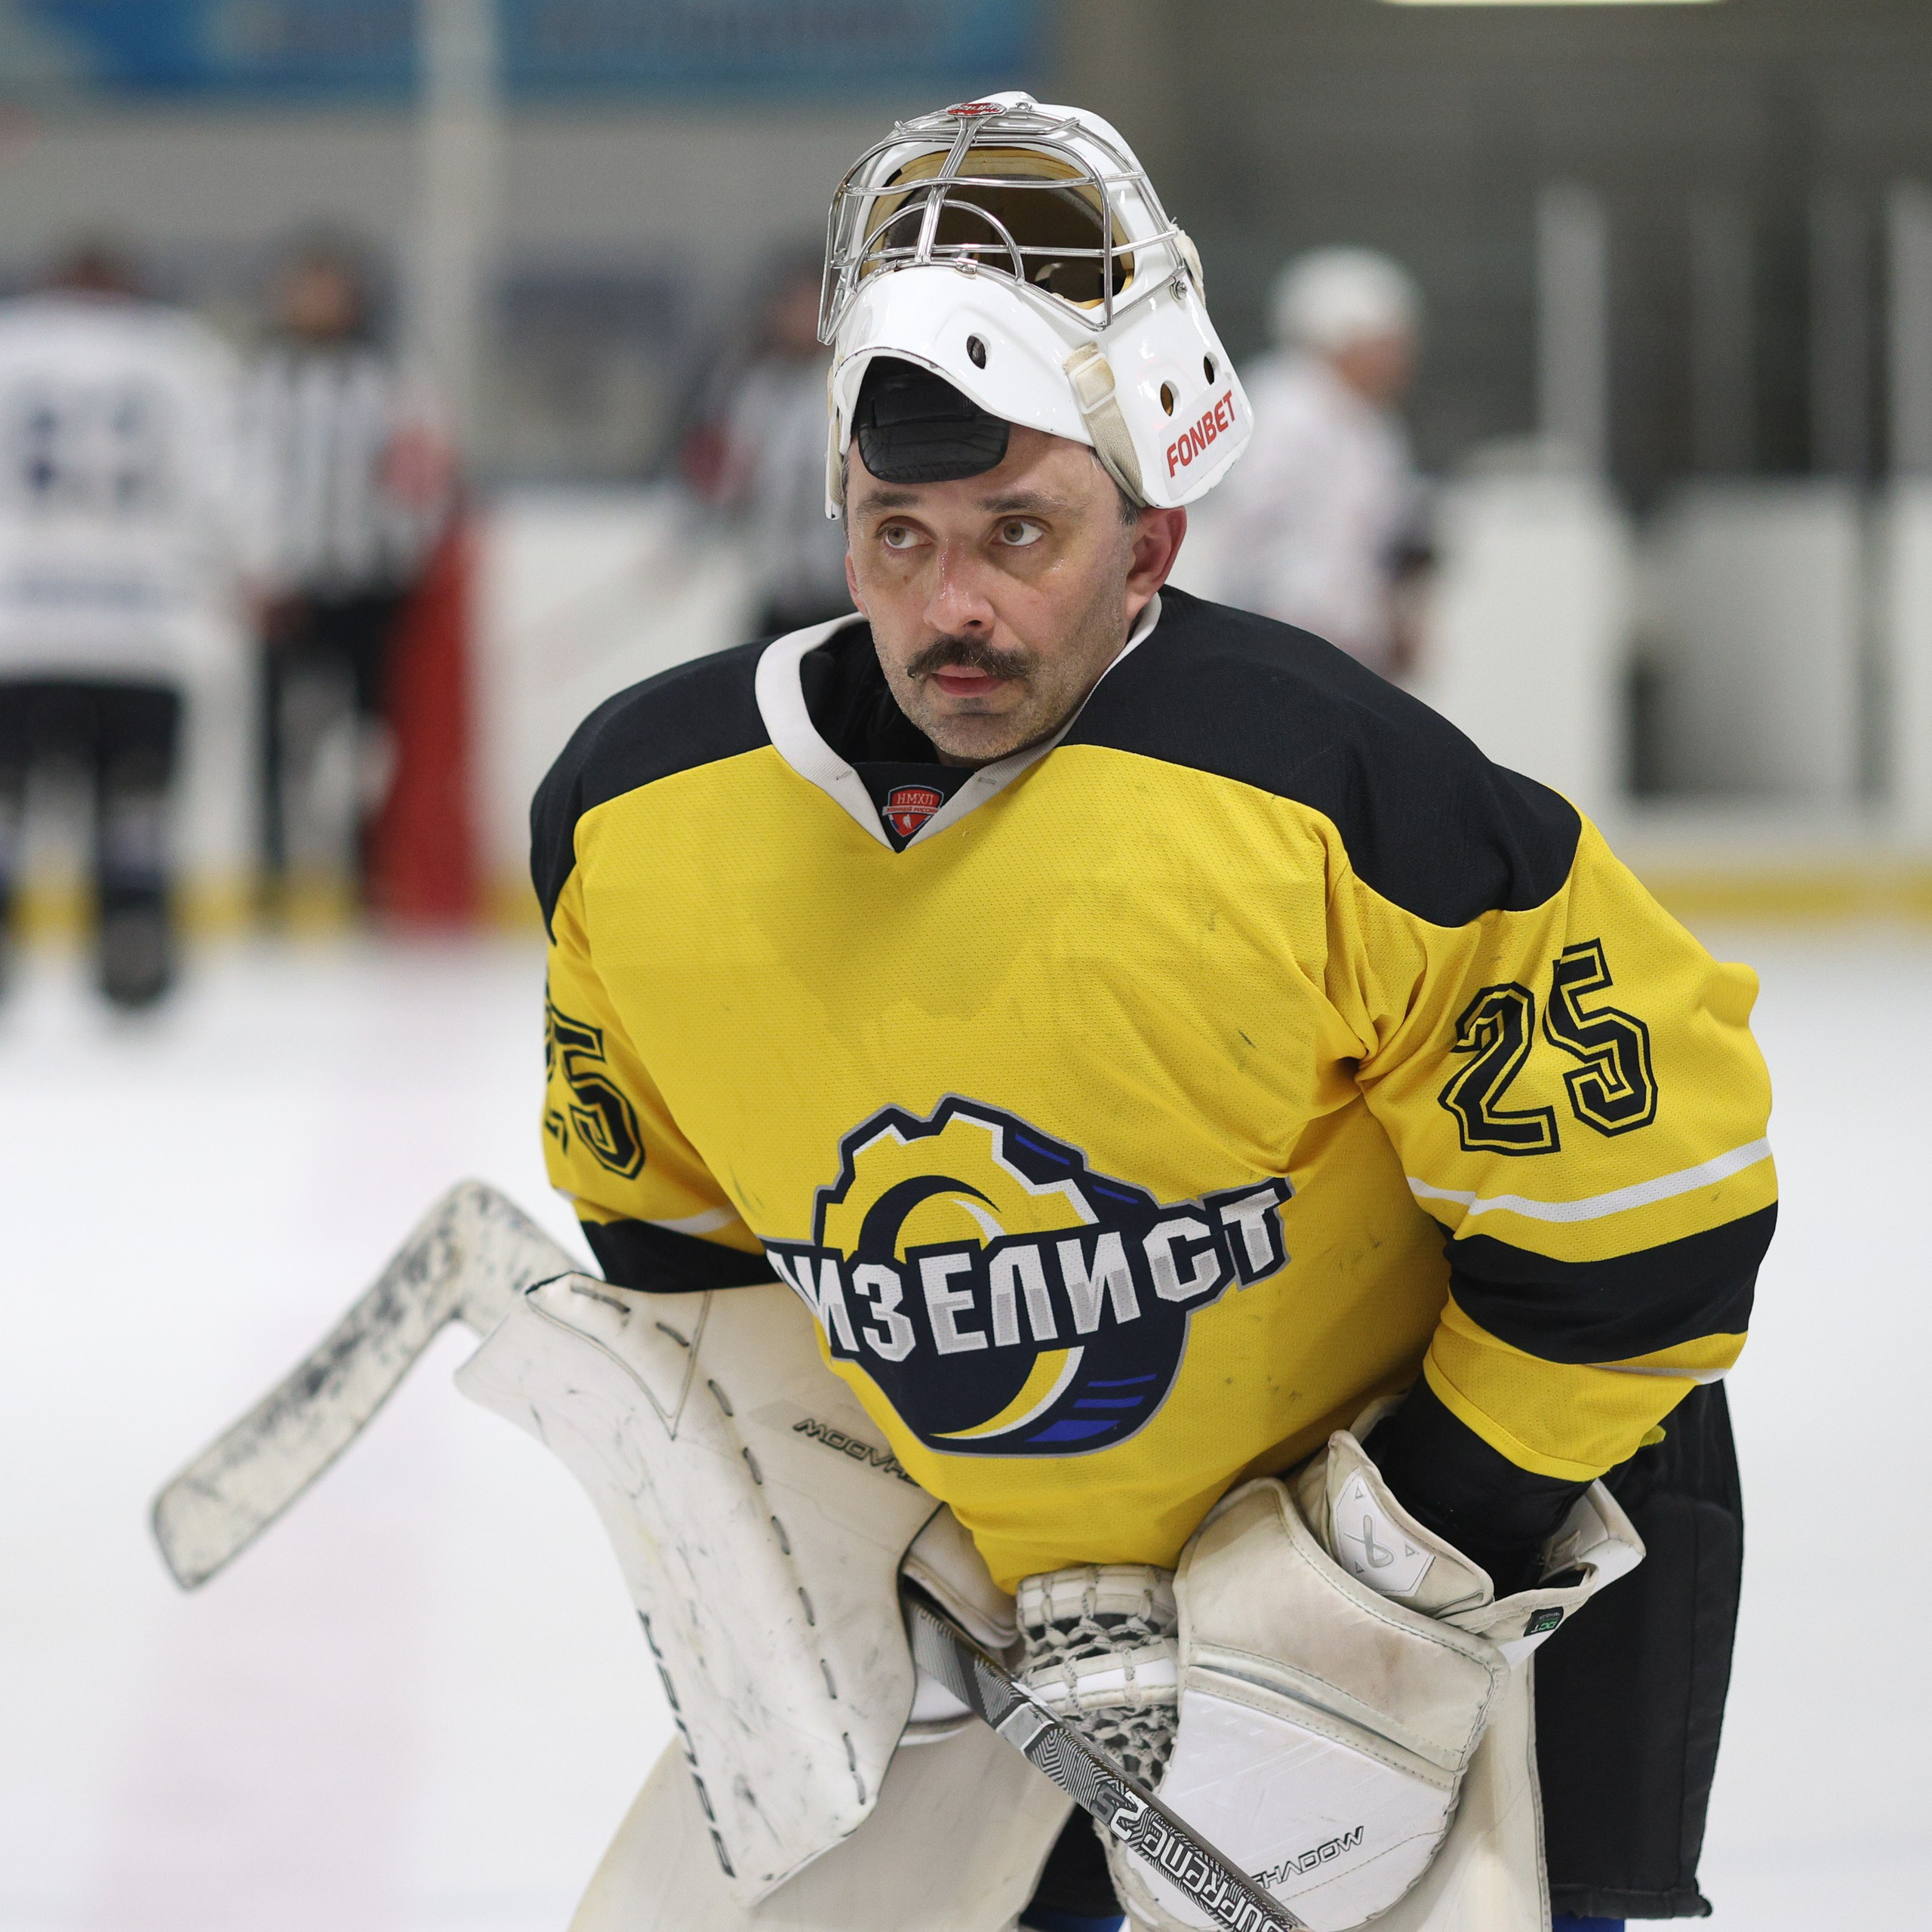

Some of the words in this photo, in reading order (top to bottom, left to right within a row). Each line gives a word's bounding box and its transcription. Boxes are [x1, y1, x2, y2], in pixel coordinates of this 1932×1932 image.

[1167, 389, 1235, 478] FONBET
[897, 792, 934, 804] НМХЛ
[545, 970, 646, 1181] 5
[1437, 937, 1659, 1157] 25
